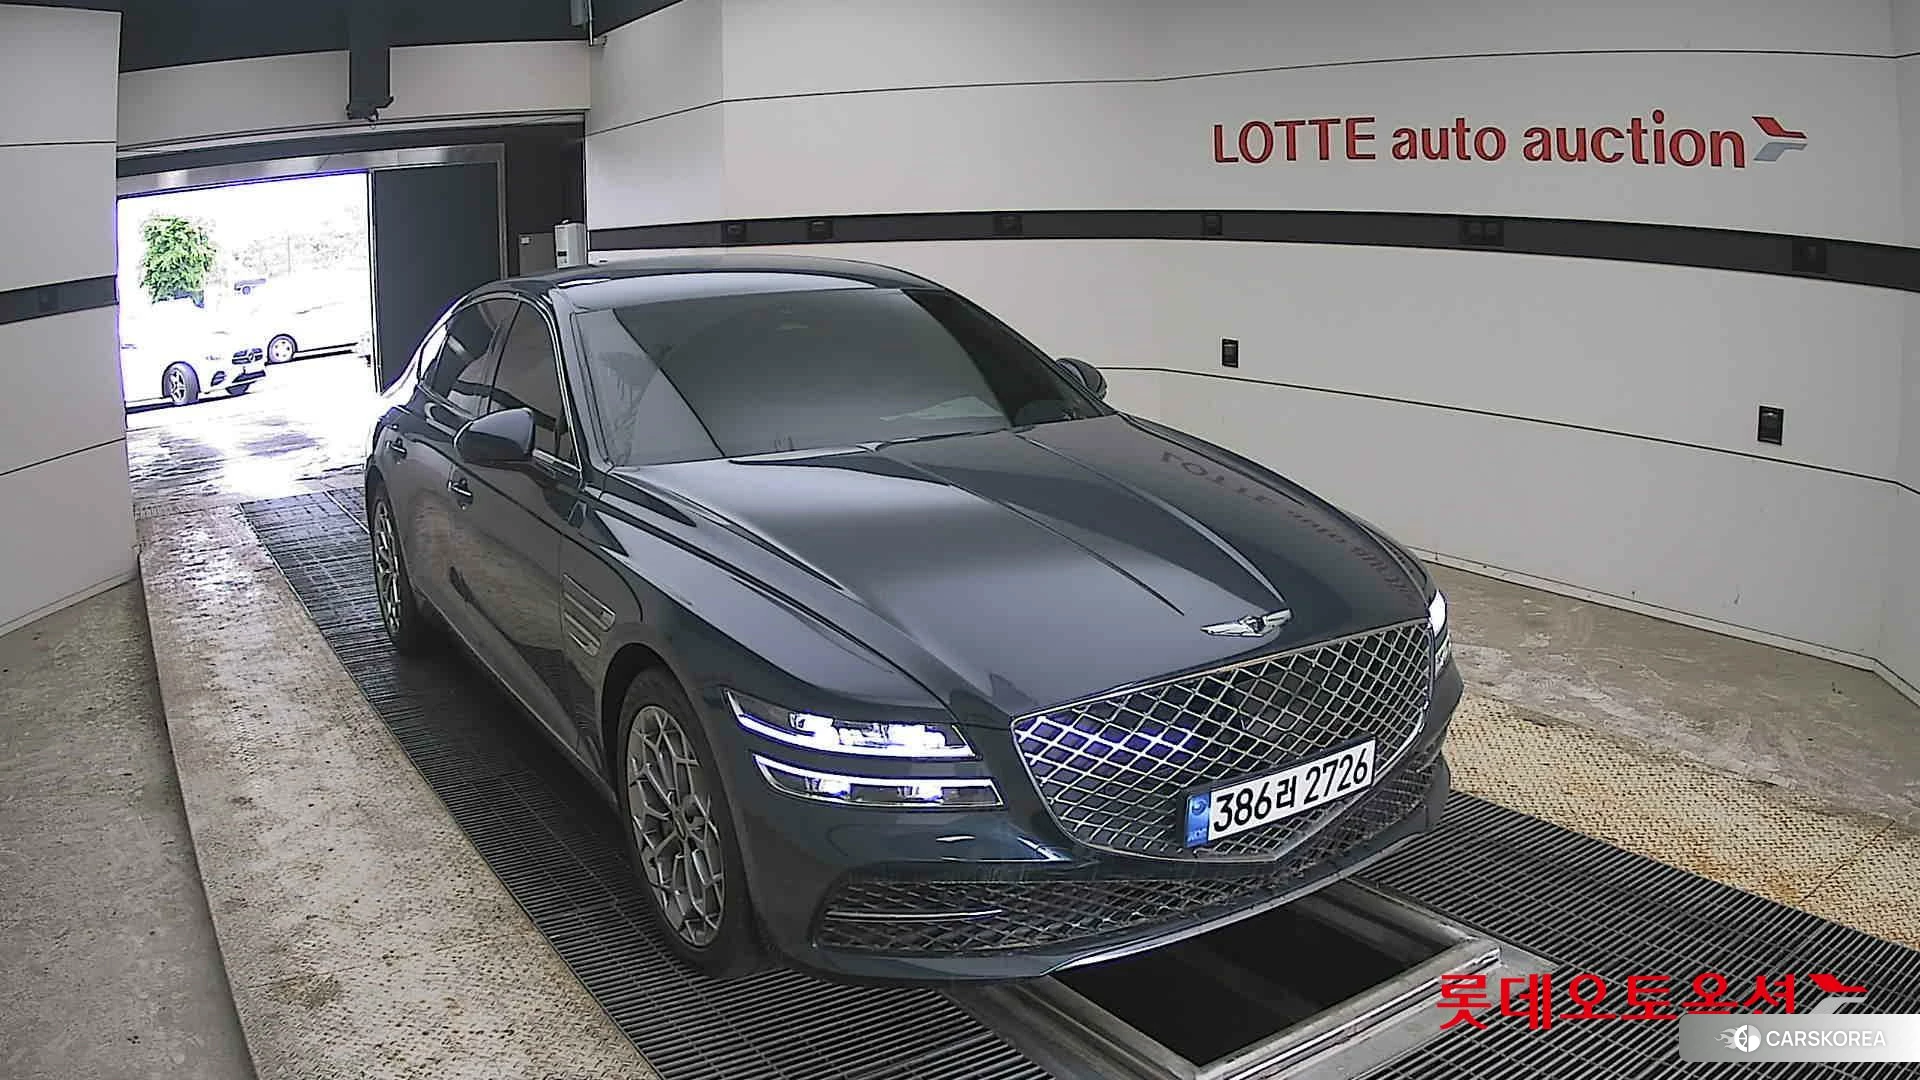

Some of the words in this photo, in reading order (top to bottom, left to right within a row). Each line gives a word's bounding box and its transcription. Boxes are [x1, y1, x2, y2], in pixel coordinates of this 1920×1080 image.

[1212, 116, 1377, 164] LOTTE
[1391, 116, 1507, 162] auto
[1523, 109, 1746, 168] auction
[1212, 775, 1298, 832] 386러
[1303, 748, 1368, 805] 2726
